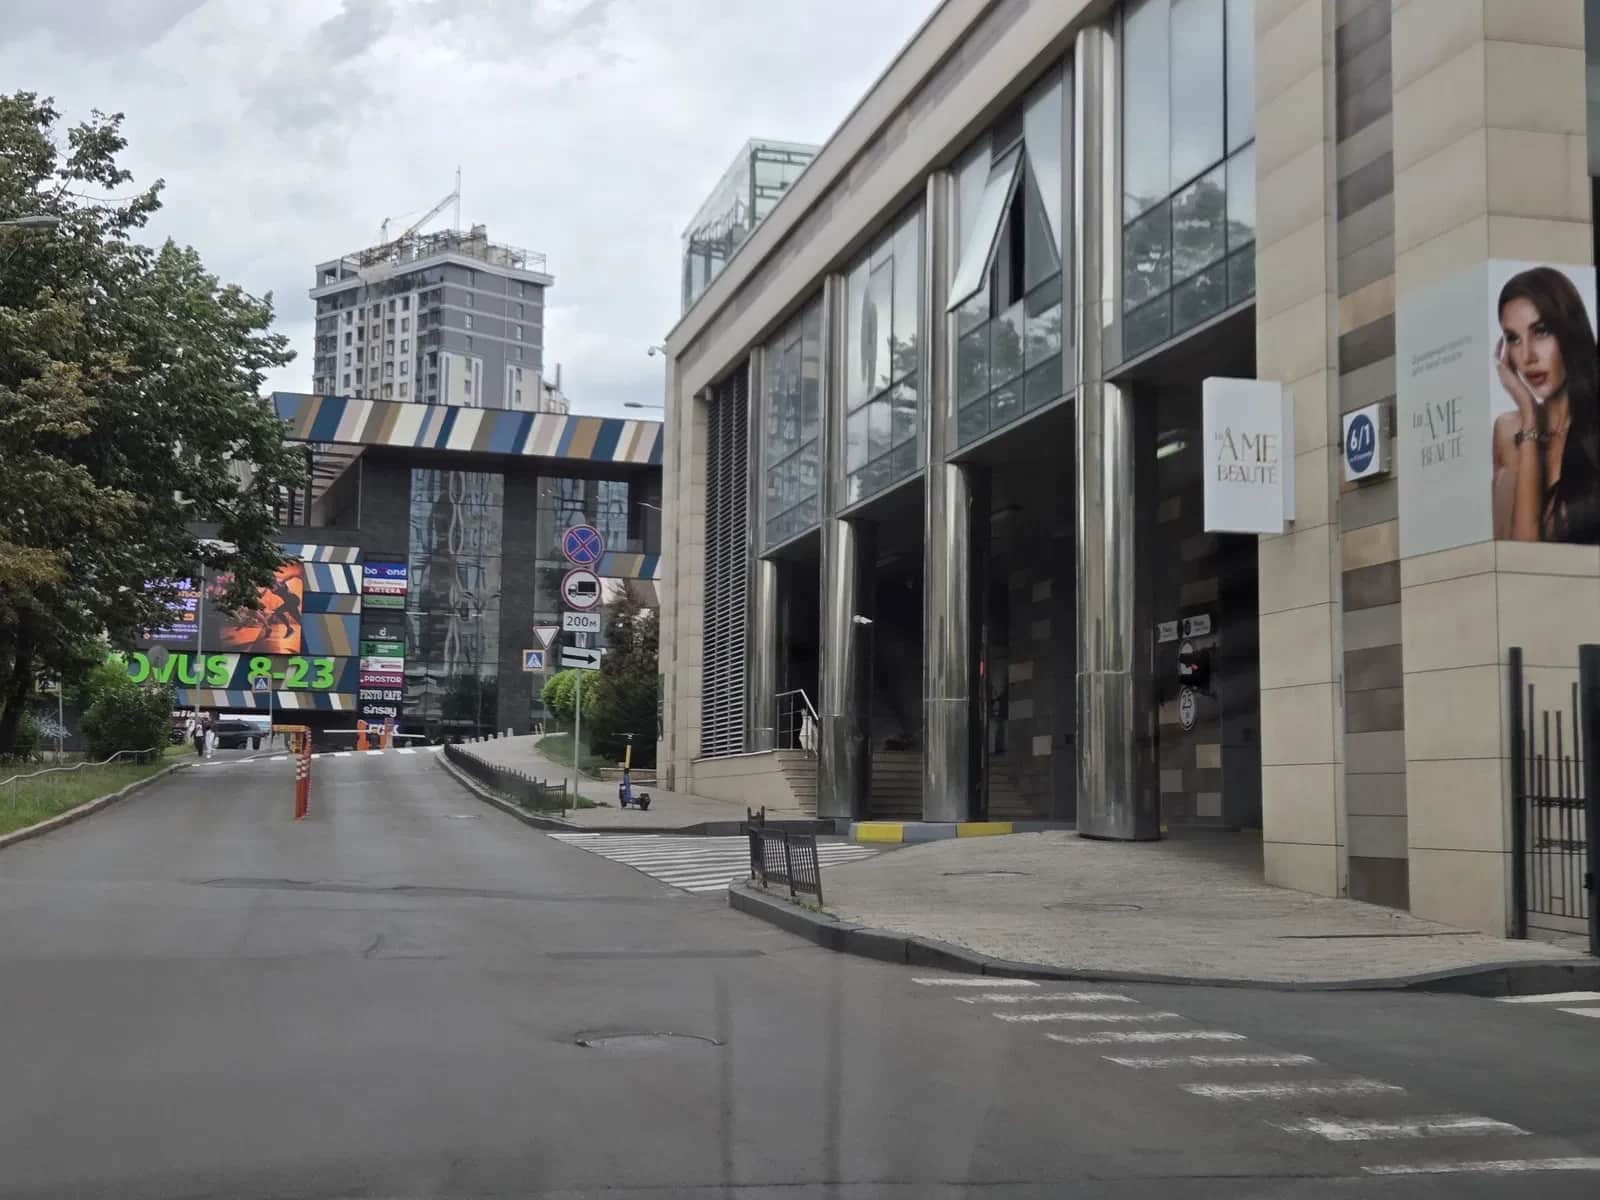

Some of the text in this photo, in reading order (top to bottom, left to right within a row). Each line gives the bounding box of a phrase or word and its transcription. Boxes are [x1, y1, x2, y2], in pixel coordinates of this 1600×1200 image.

[1350, 423, 1370, 452] 6/1
[110, 652, 335, 689] OVUS 8-23
[364, 675, 402, 683] PROSTOR
[363, 704, 397, 717] sinsay
